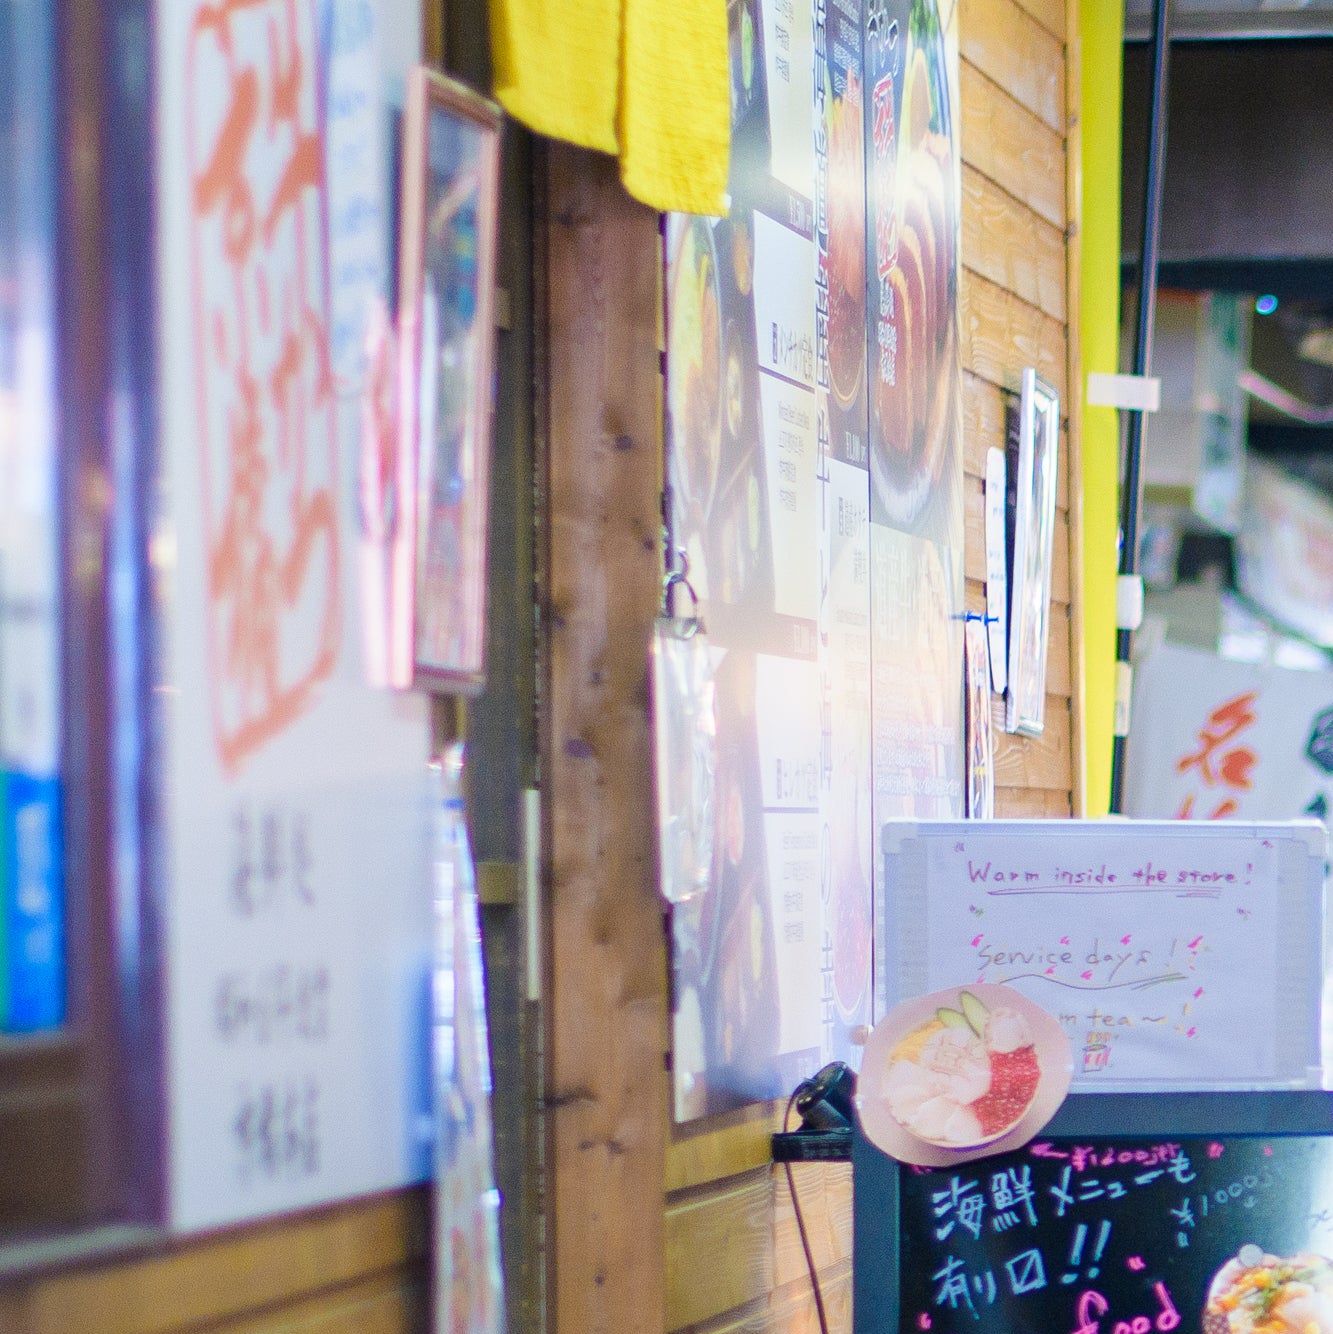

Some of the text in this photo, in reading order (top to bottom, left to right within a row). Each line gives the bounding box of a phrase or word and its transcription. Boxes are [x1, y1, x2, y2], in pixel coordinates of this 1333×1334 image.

[968, 860, 1040, 884] Warm
[1054, 864, 1118, 885] inside
[1132, 862, 1167, 887] the
[977, 944, 1073, 971] Service
